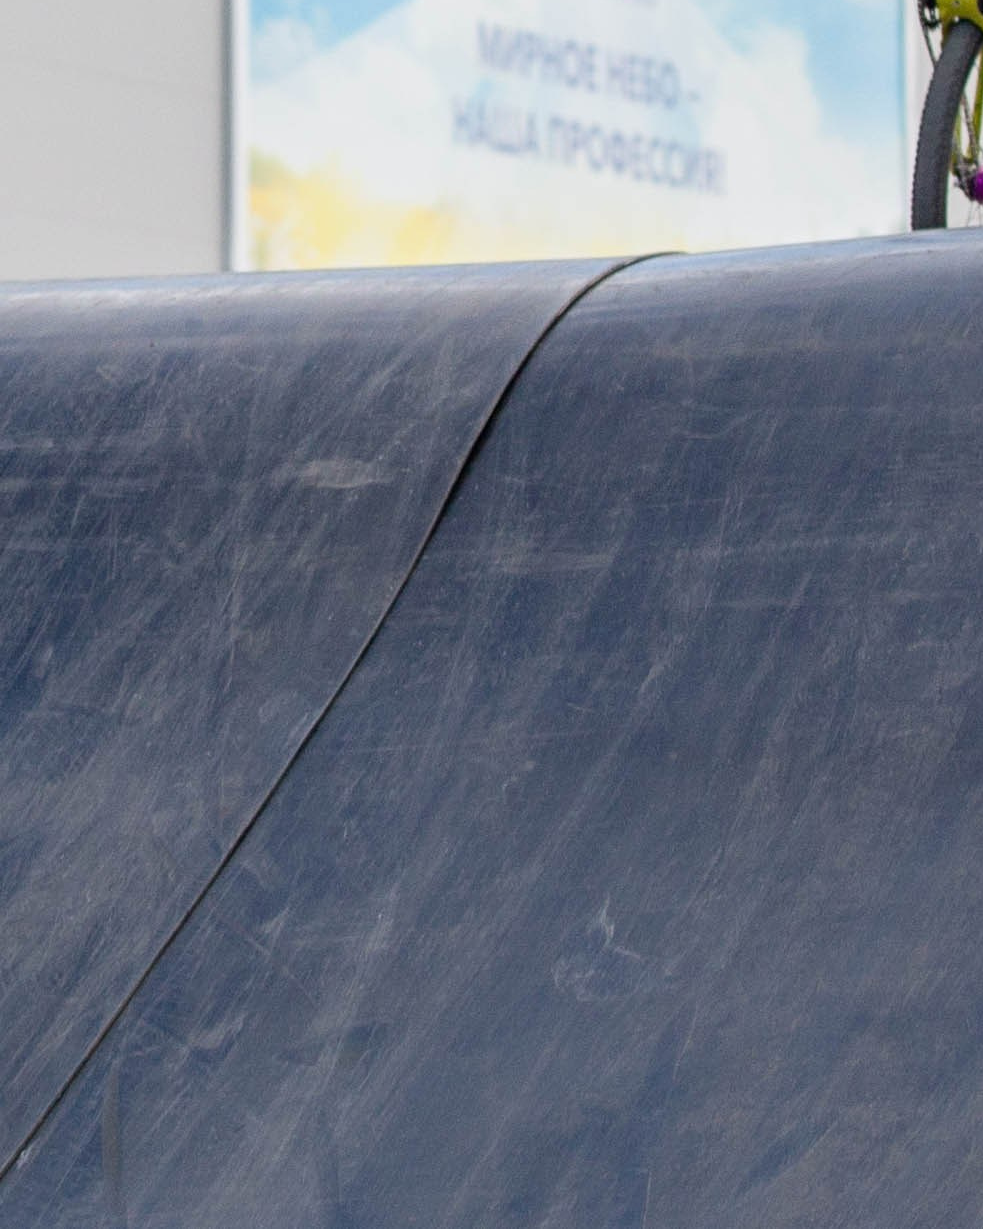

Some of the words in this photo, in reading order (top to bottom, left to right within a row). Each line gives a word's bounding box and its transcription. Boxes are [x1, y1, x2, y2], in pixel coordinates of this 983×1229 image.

[477, 21, 597, 92] МИРНОЕ
[606, 51, 681, 109] НЕБО
[452, 96, 540, 155] НАША
